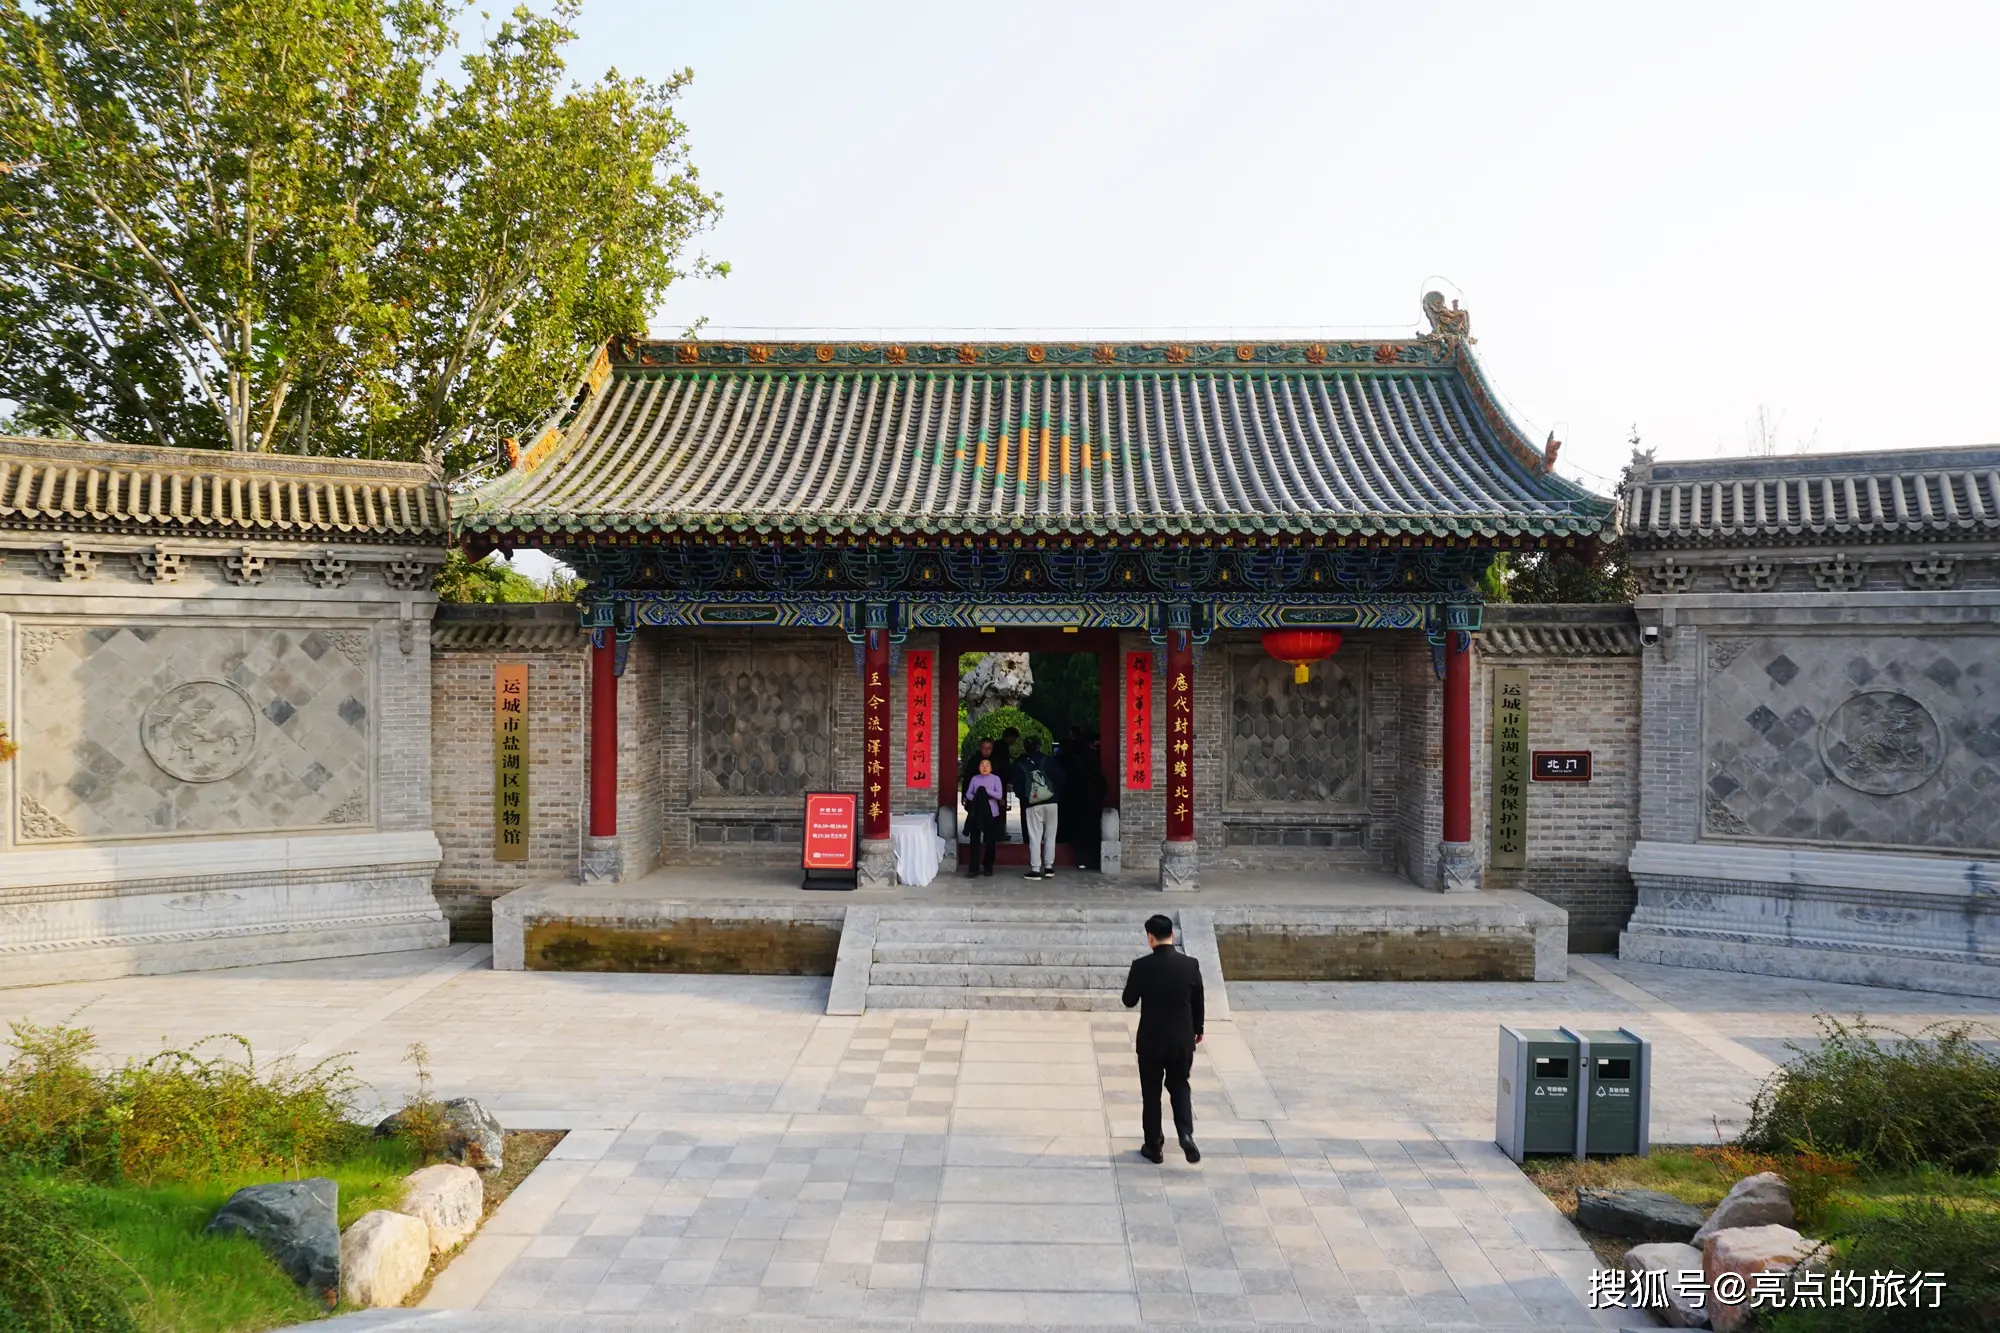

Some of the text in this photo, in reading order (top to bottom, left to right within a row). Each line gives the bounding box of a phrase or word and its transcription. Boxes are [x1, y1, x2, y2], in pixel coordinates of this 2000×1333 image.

[502, 679, 521, 845] 运城市盐湖区博物馆
[1500, 683, 1521, 853] 运城市盐湖区文物保护中心
[1547, 759, 1577, 769] 北门
